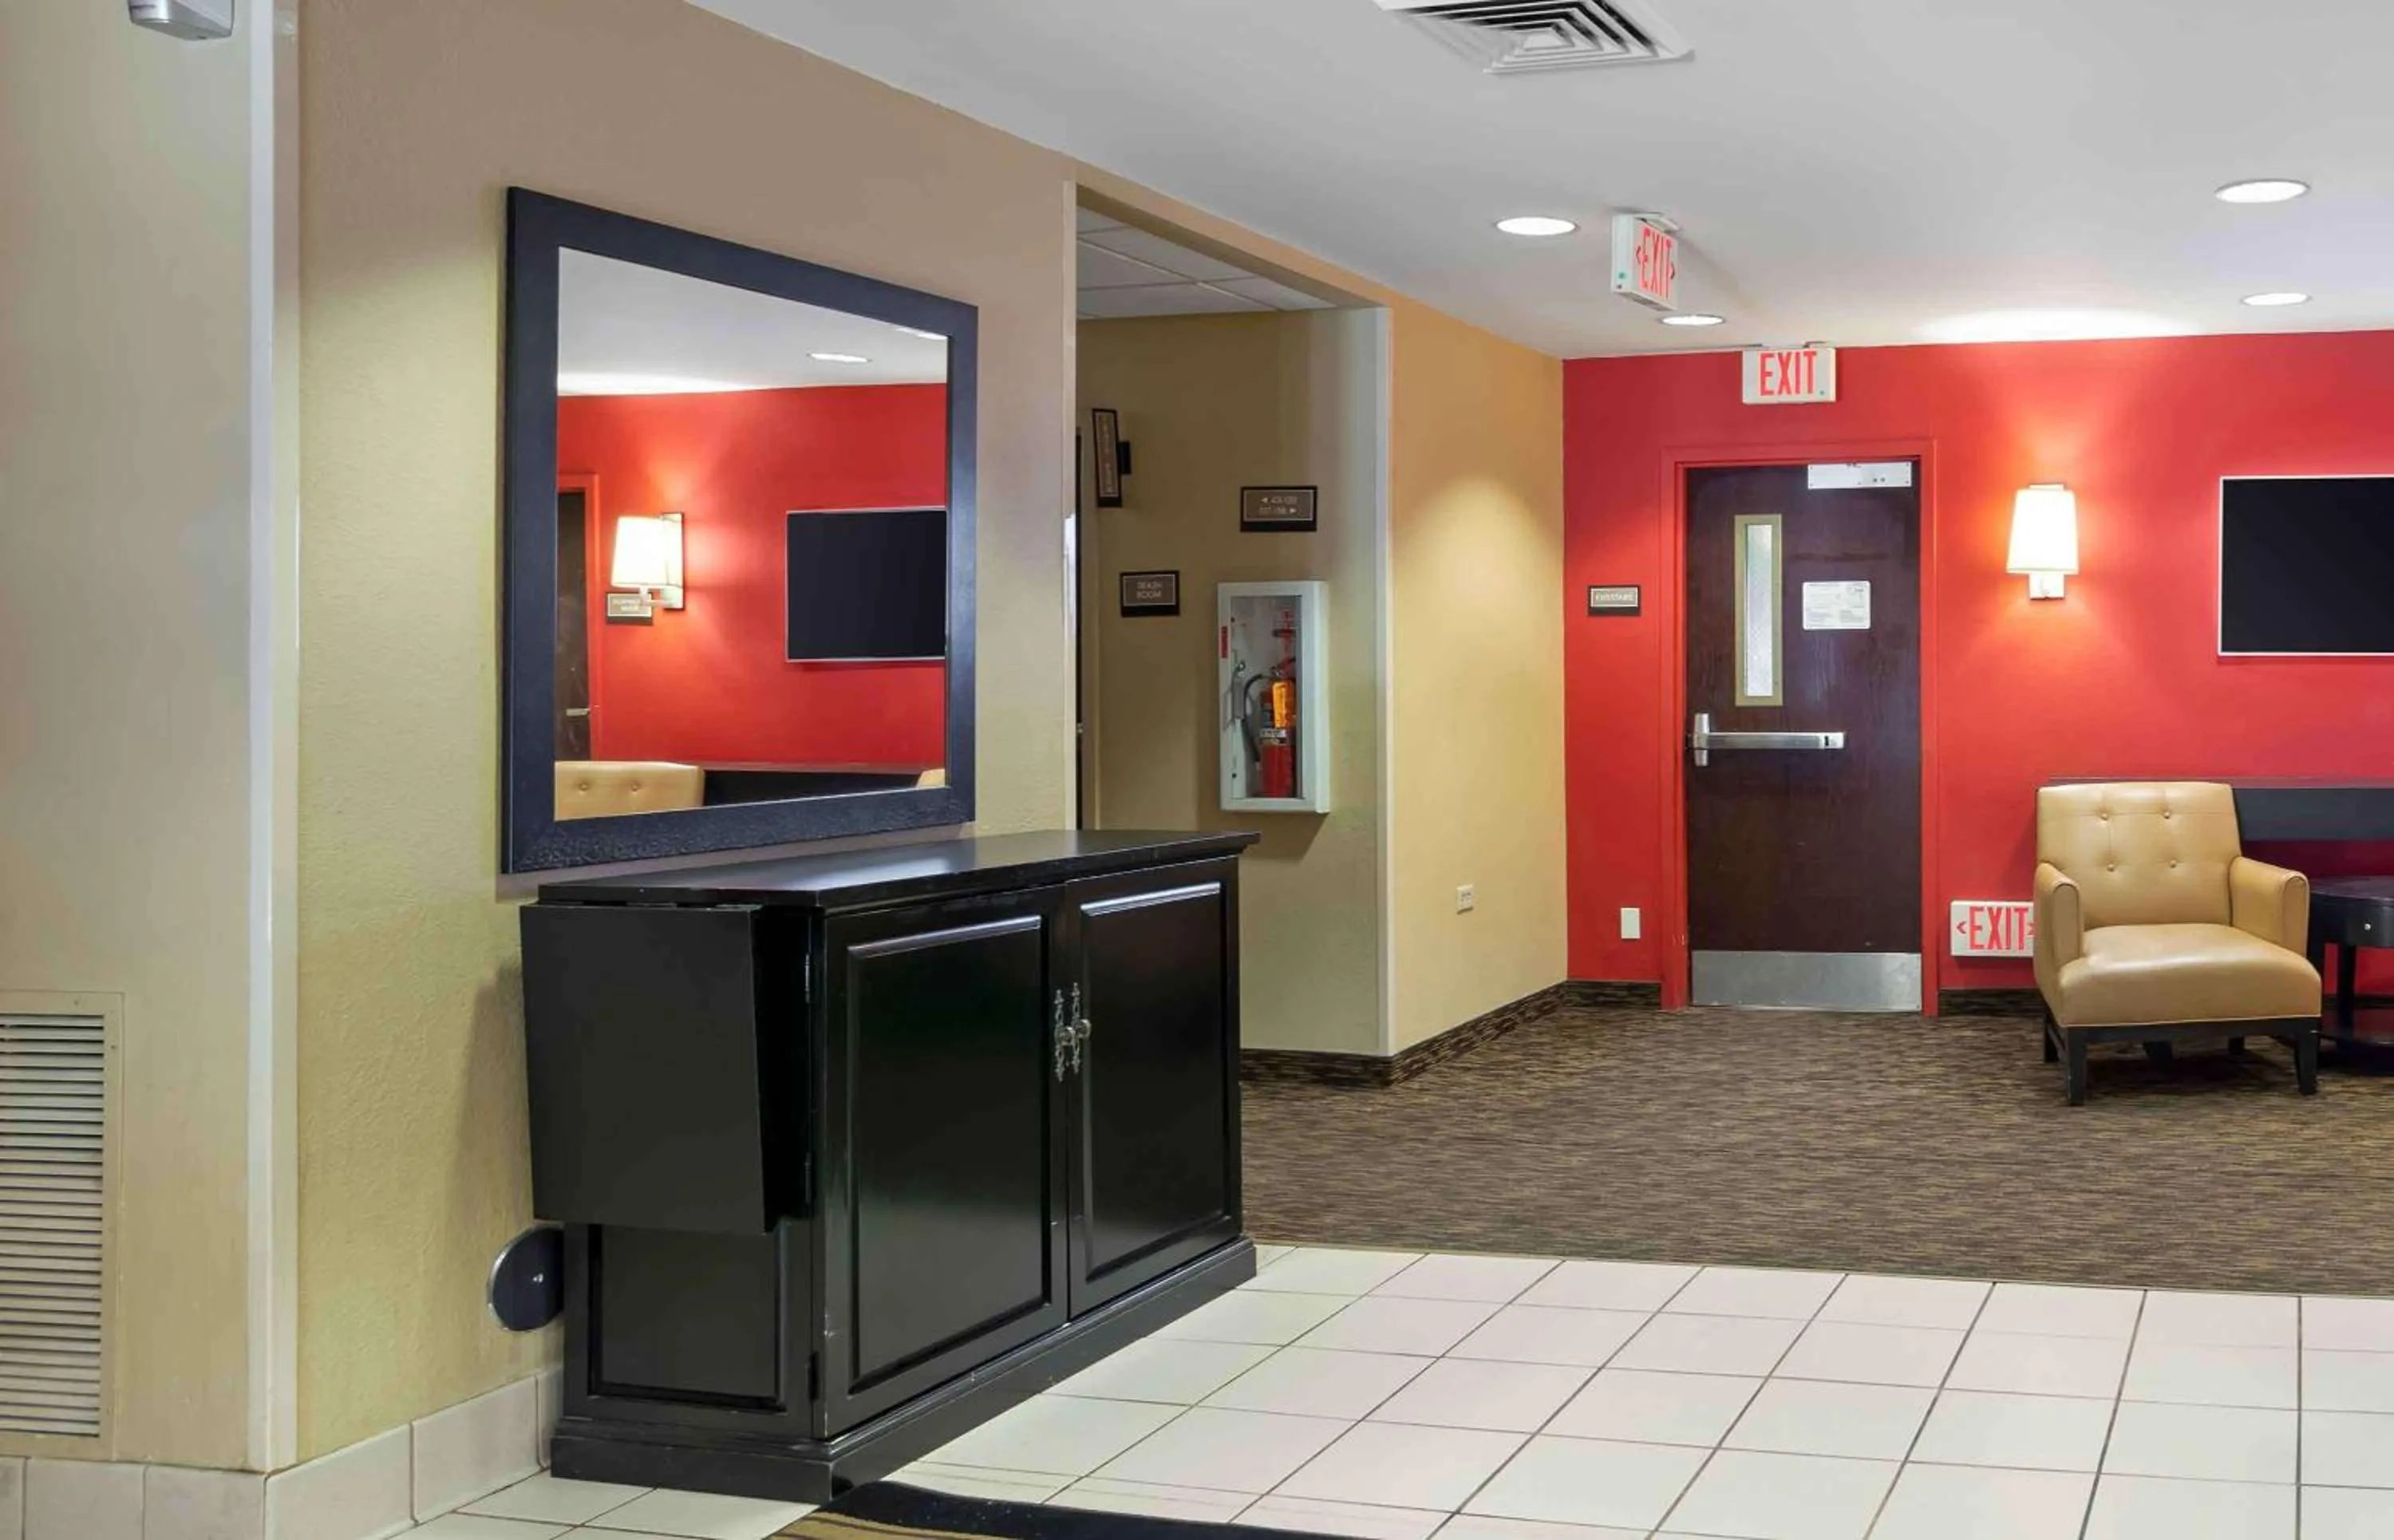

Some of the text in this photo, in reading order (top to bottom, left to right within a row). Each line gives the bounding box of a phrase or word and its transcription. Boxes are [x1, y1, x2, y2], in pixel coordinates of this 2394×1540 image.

[1640, 226, 1672, 300] EXIT
[1760, 351, 1817, 396] EXIT
[1969, 906, 2029, 950] EXIT
